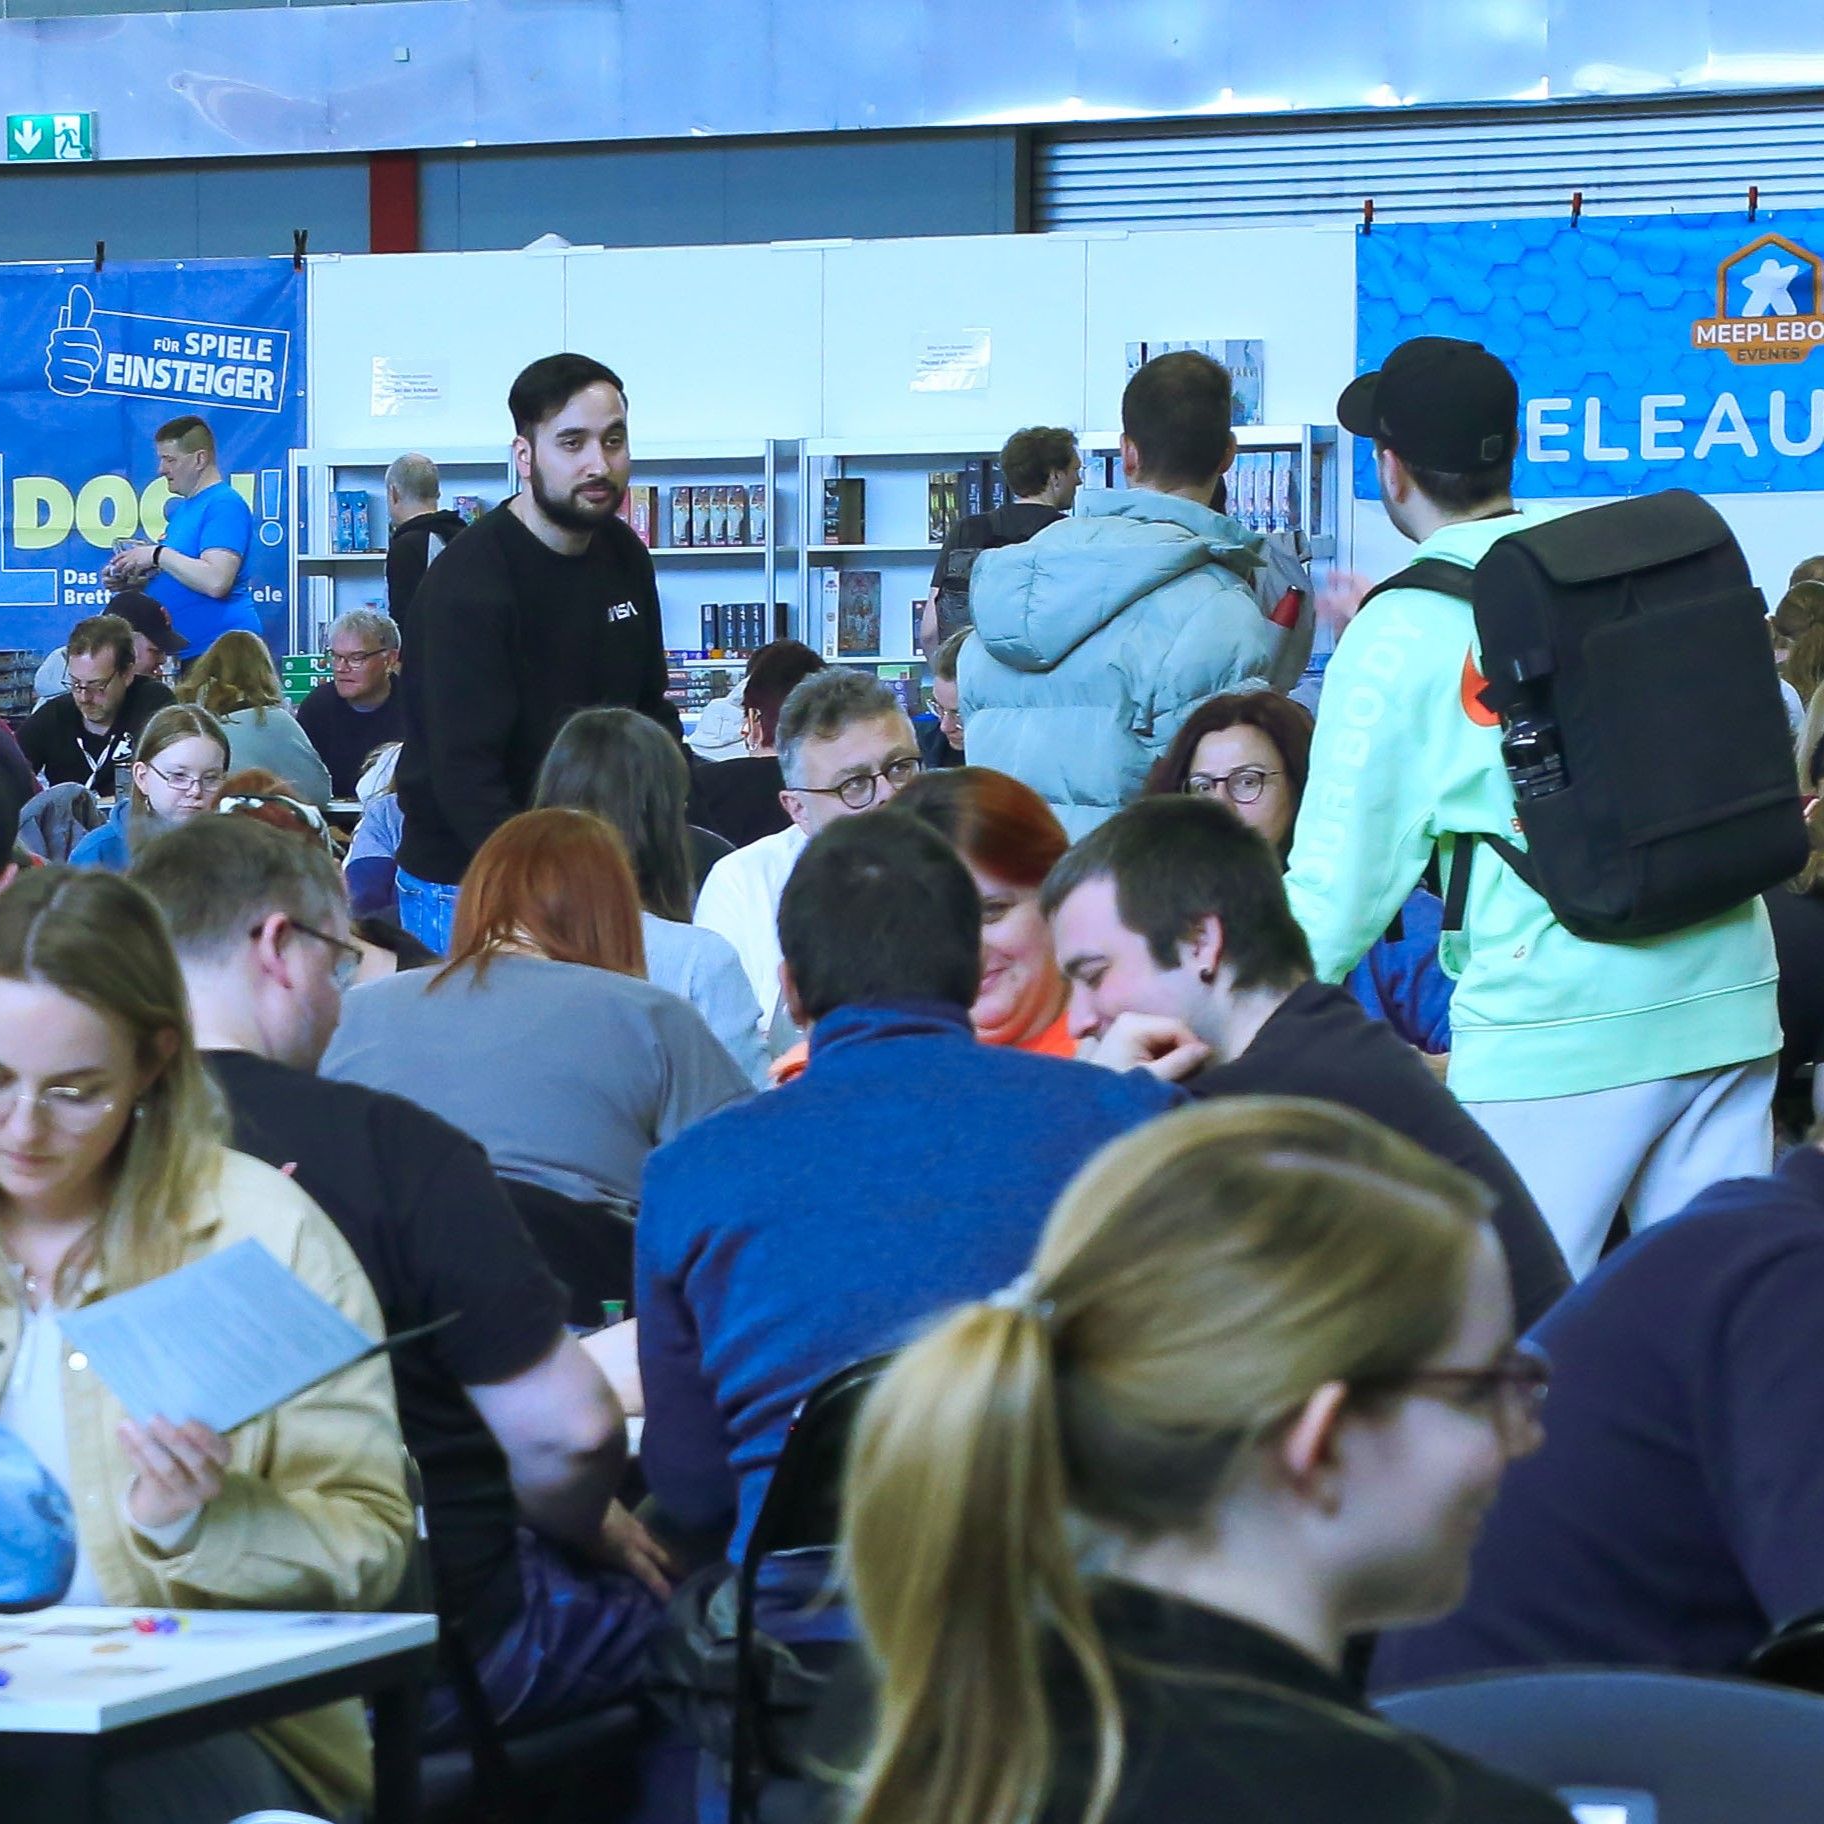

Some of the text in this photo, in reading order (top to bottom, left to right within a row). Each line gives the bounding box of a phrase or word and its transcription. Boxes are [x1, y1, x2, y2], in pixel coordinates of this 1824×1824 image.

[153, 332, 273, 362] FÜR SPIELE
[1736, 346, 1801, 362] EVENTS
[105, 352, 275, 401] EINSTEIGER
[64, 569, 97, 585] Das
